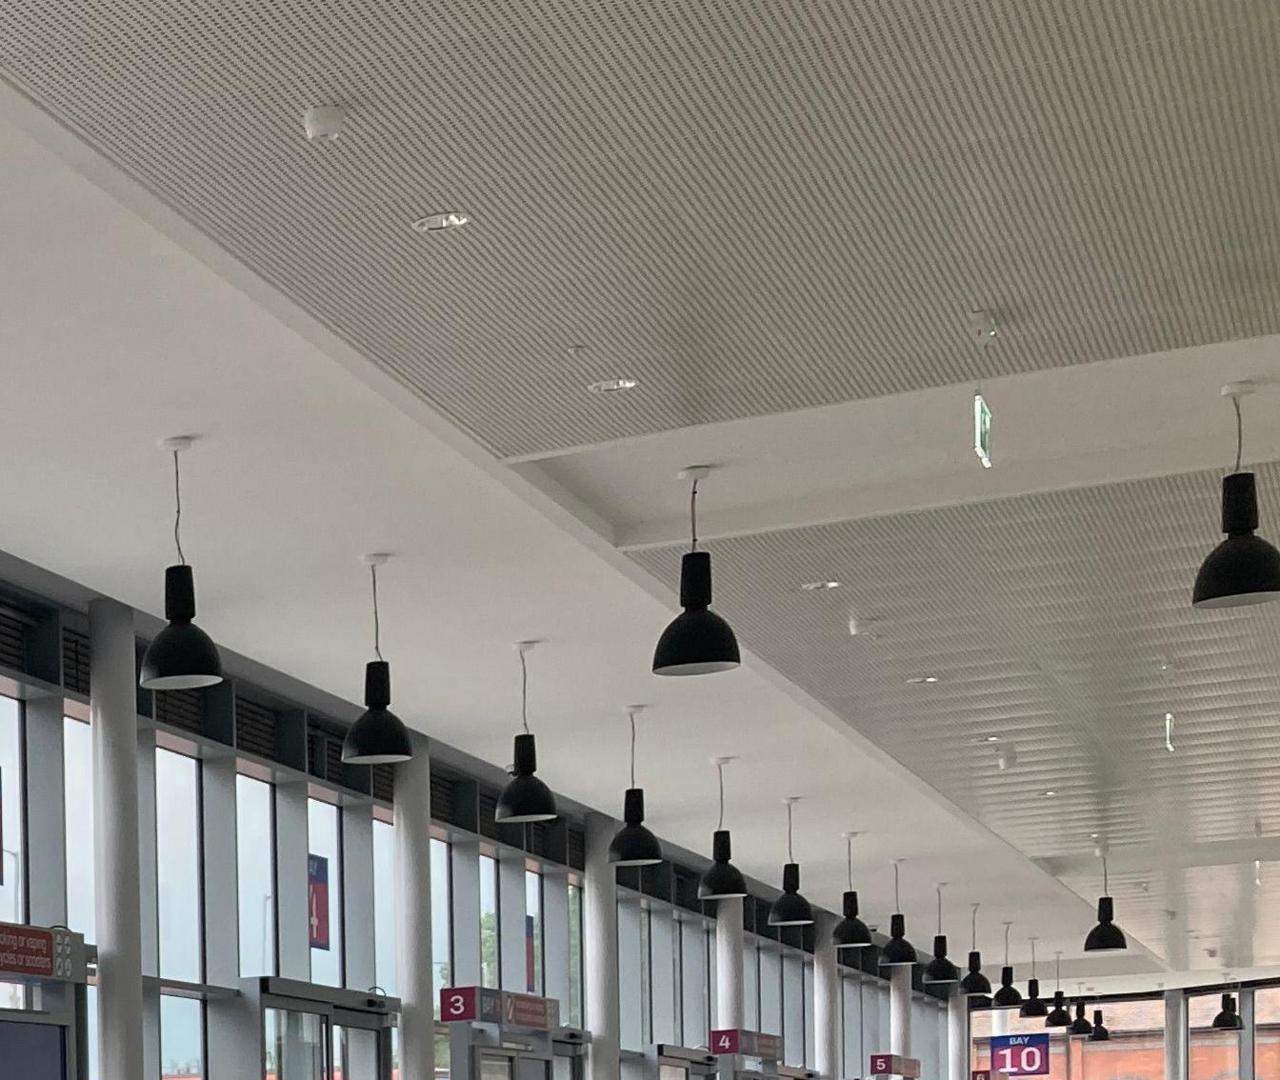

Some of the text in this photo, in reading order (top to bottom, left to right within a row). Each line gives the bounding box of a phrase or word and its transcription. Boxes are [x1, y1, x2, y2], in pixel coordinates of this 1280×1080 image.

[449, 995, 465, 1015] 3
[719, 1034, 731, 1049] 4
[1008, 1036, 1030, 1046] BAY
[876, 1058, 886, 1070] 5
[998, 1046, 1041, 1072] 10
